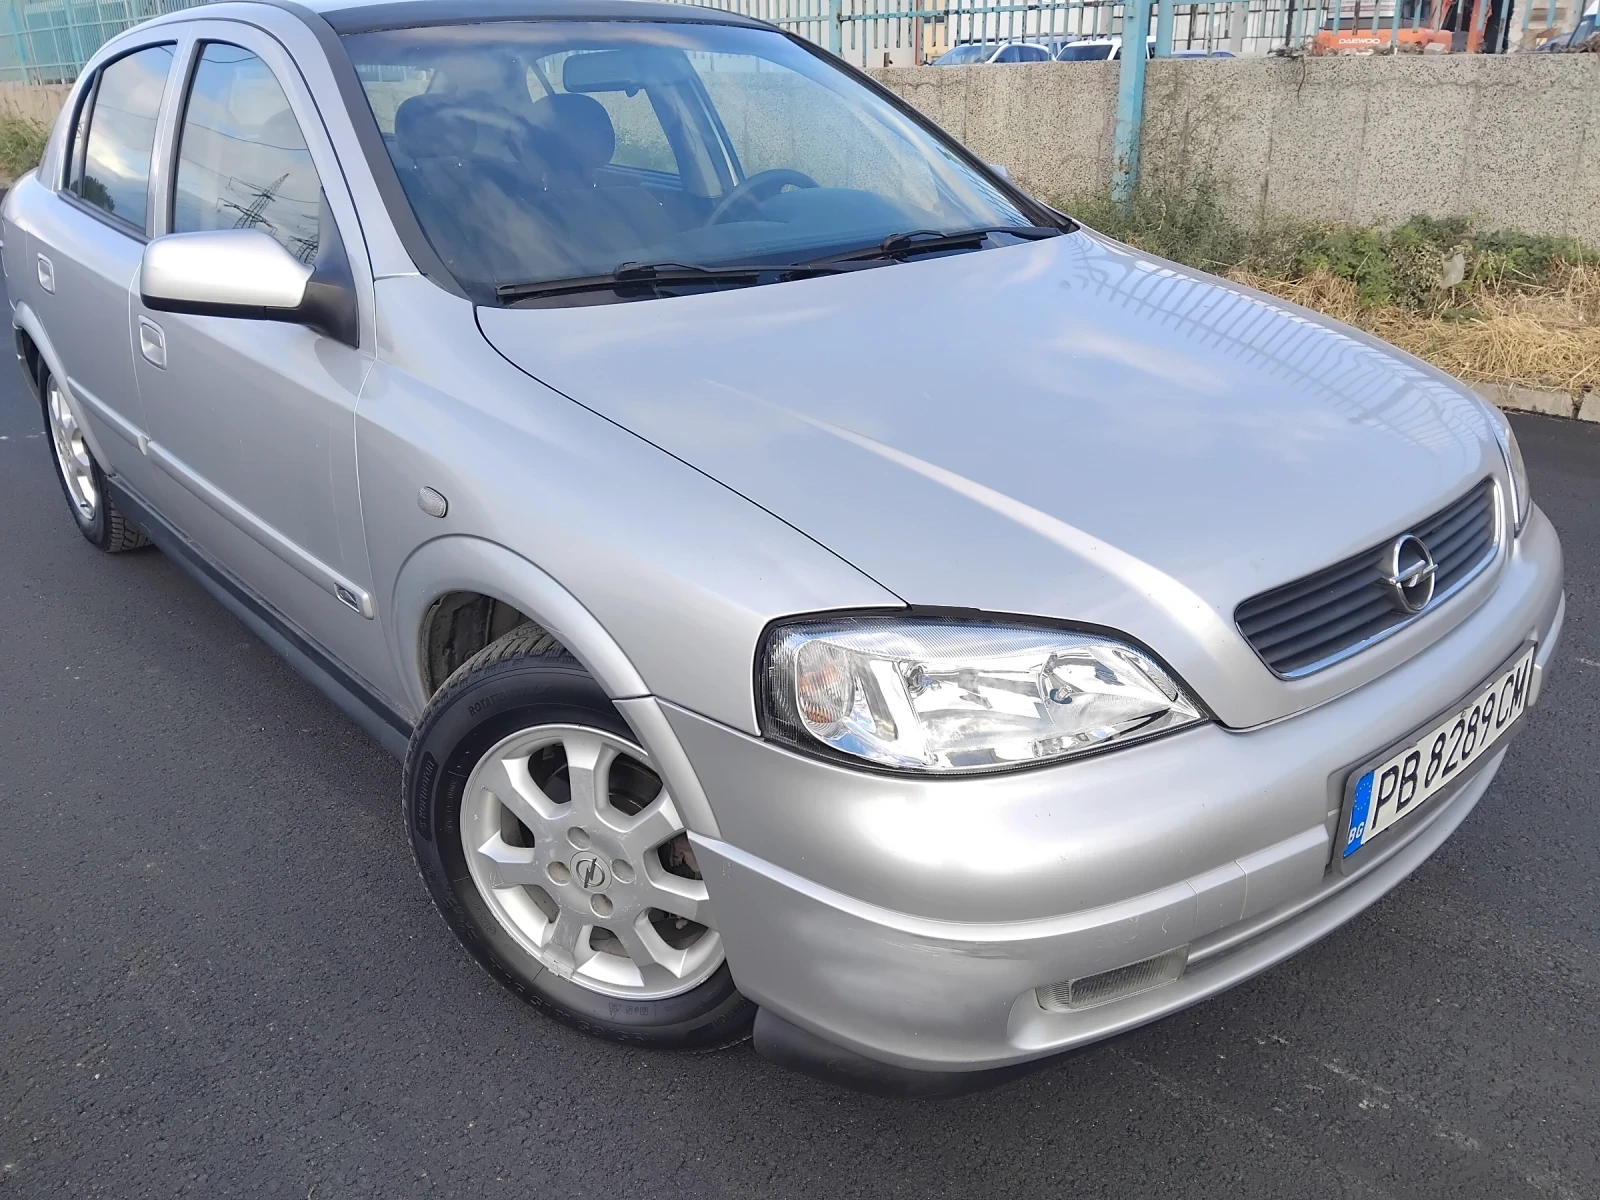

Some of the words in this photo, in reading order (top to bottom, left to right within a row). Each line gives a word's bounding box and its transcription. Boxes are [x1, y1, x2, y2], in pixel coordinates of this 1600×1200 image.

[1371, 749, 1421, 830] PB
[1424, 692, 1496, 789] 8289
[1496, 658, 1530, 727] CM
[1347, 822, 1364, 844] BG
